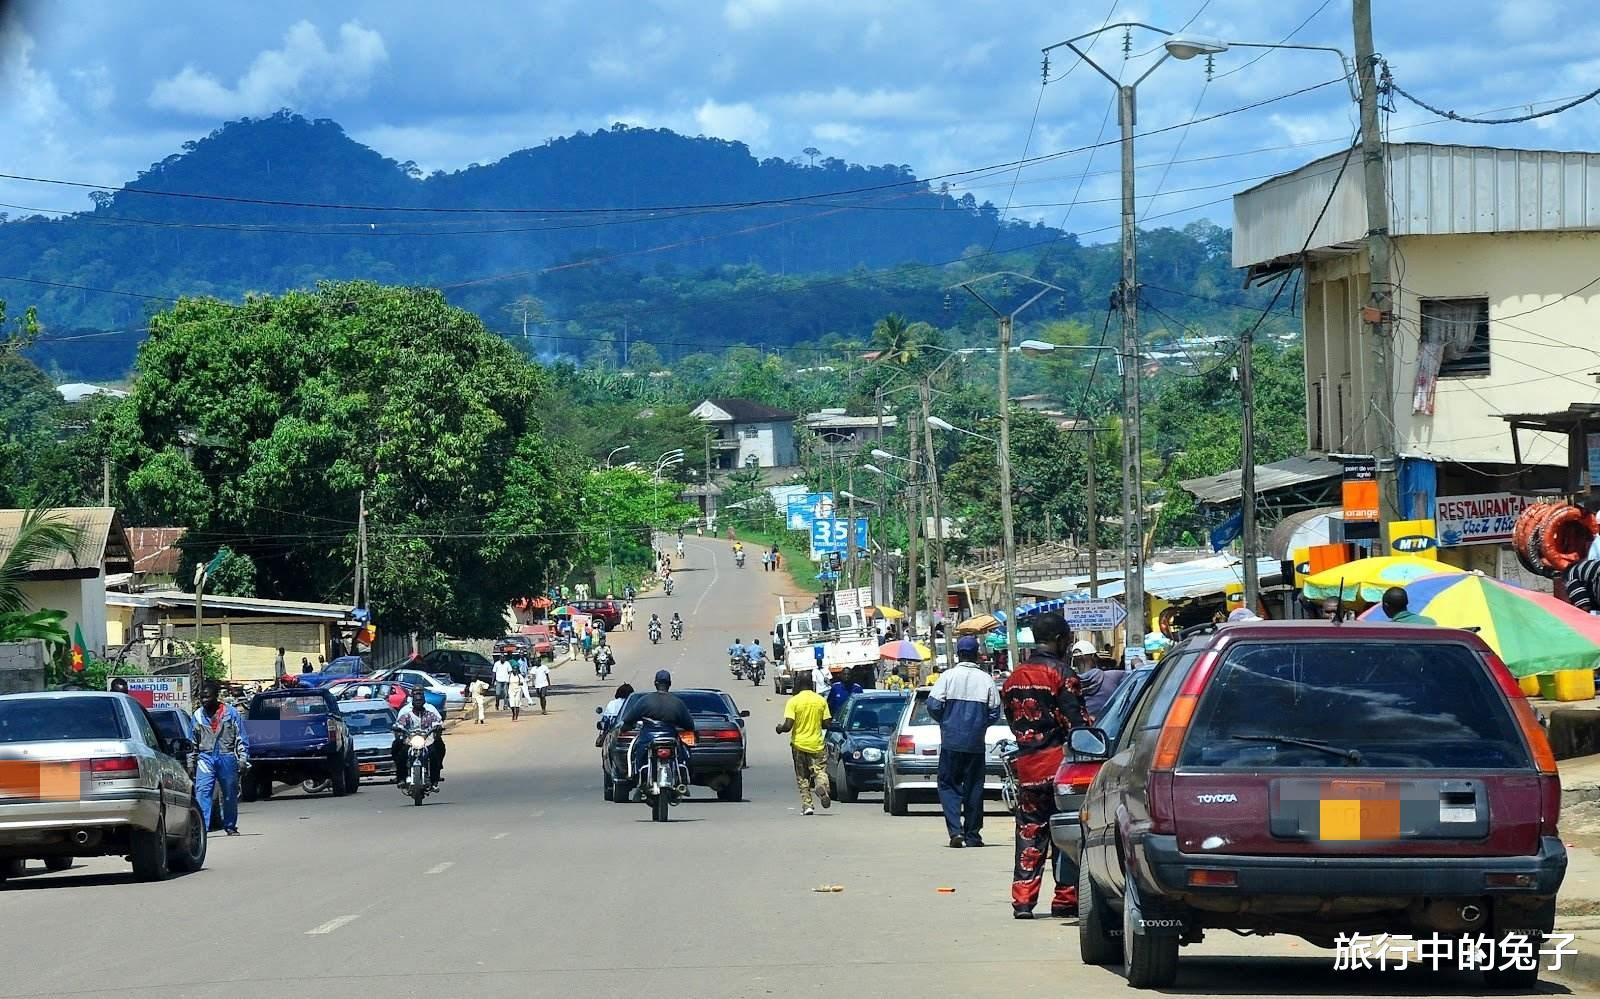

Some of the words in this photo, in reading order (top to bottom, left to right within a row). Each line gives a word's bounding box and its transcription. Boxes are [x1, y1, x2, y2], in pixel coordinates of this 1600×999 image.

[1346, 509, 1378, 518] orange
[1400, 538, 1428, 549] MTN
[154, 693, 187, 701] ERNELLE
[1197, 794, 1238, 803] TOYOTA
[1139, 919, 1183, 927] TOYOTA
